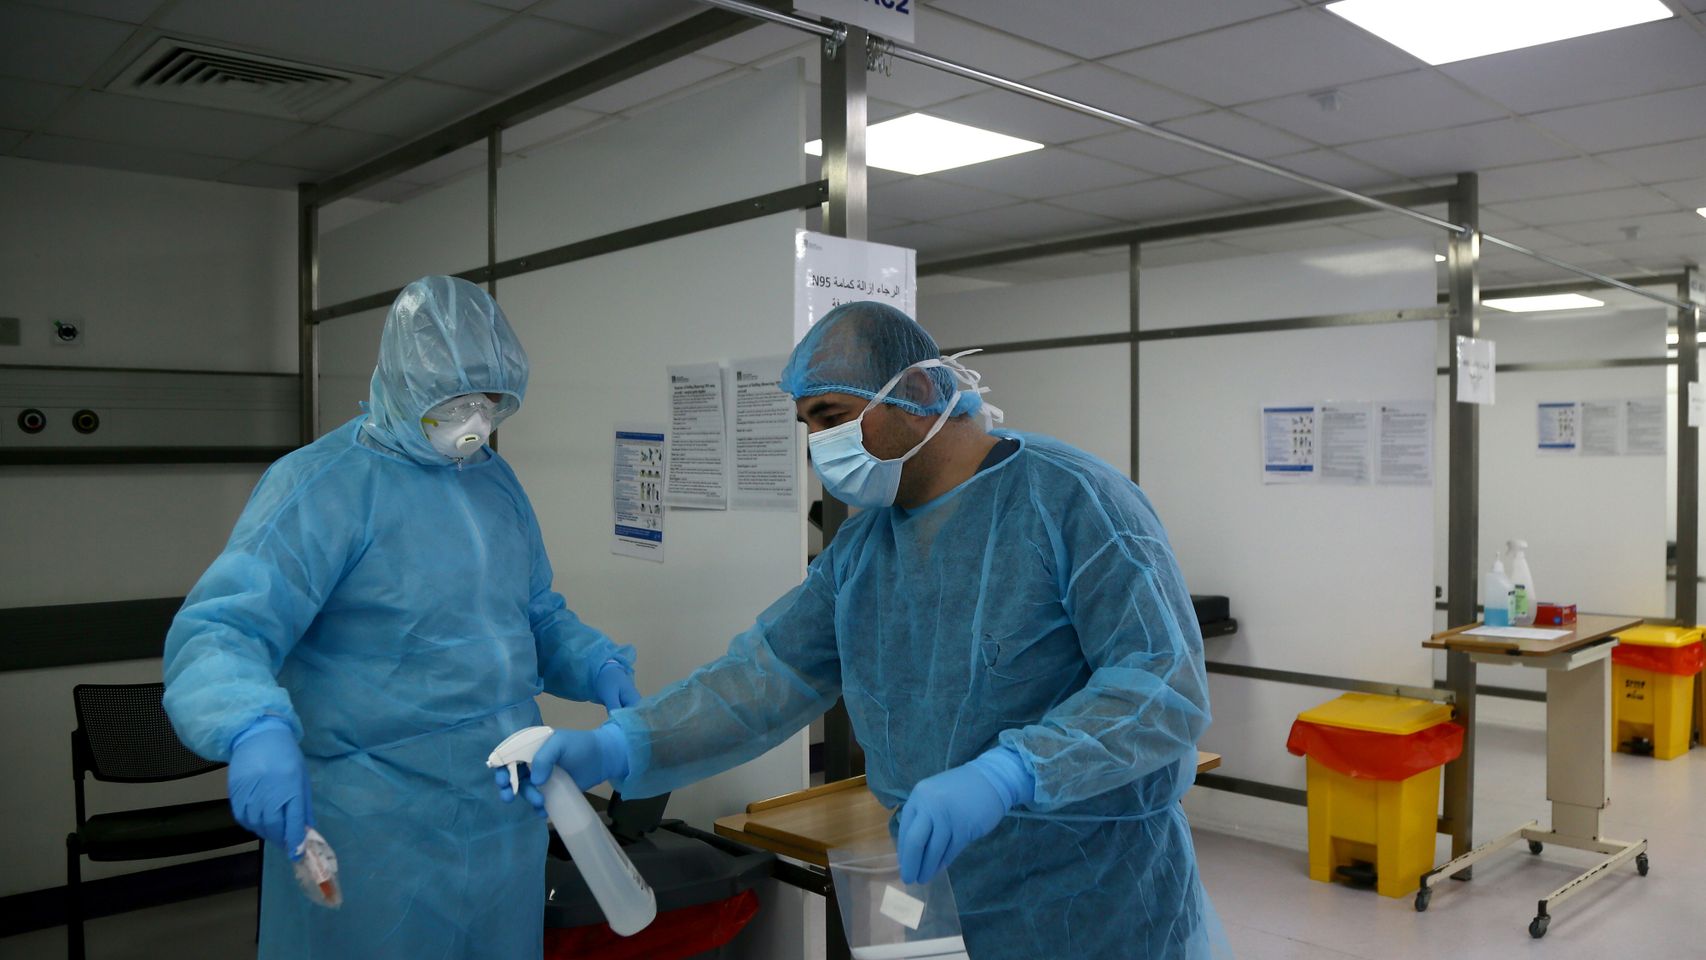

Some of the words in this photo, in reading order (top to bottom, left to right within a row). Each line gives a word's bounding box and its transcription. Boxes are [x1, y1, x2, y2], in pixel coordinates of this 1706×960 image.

[812, 274, 831, 288] N95
[833, 276, 855, 289] كمامة
[877, 284, 900, 298] الرجاء
